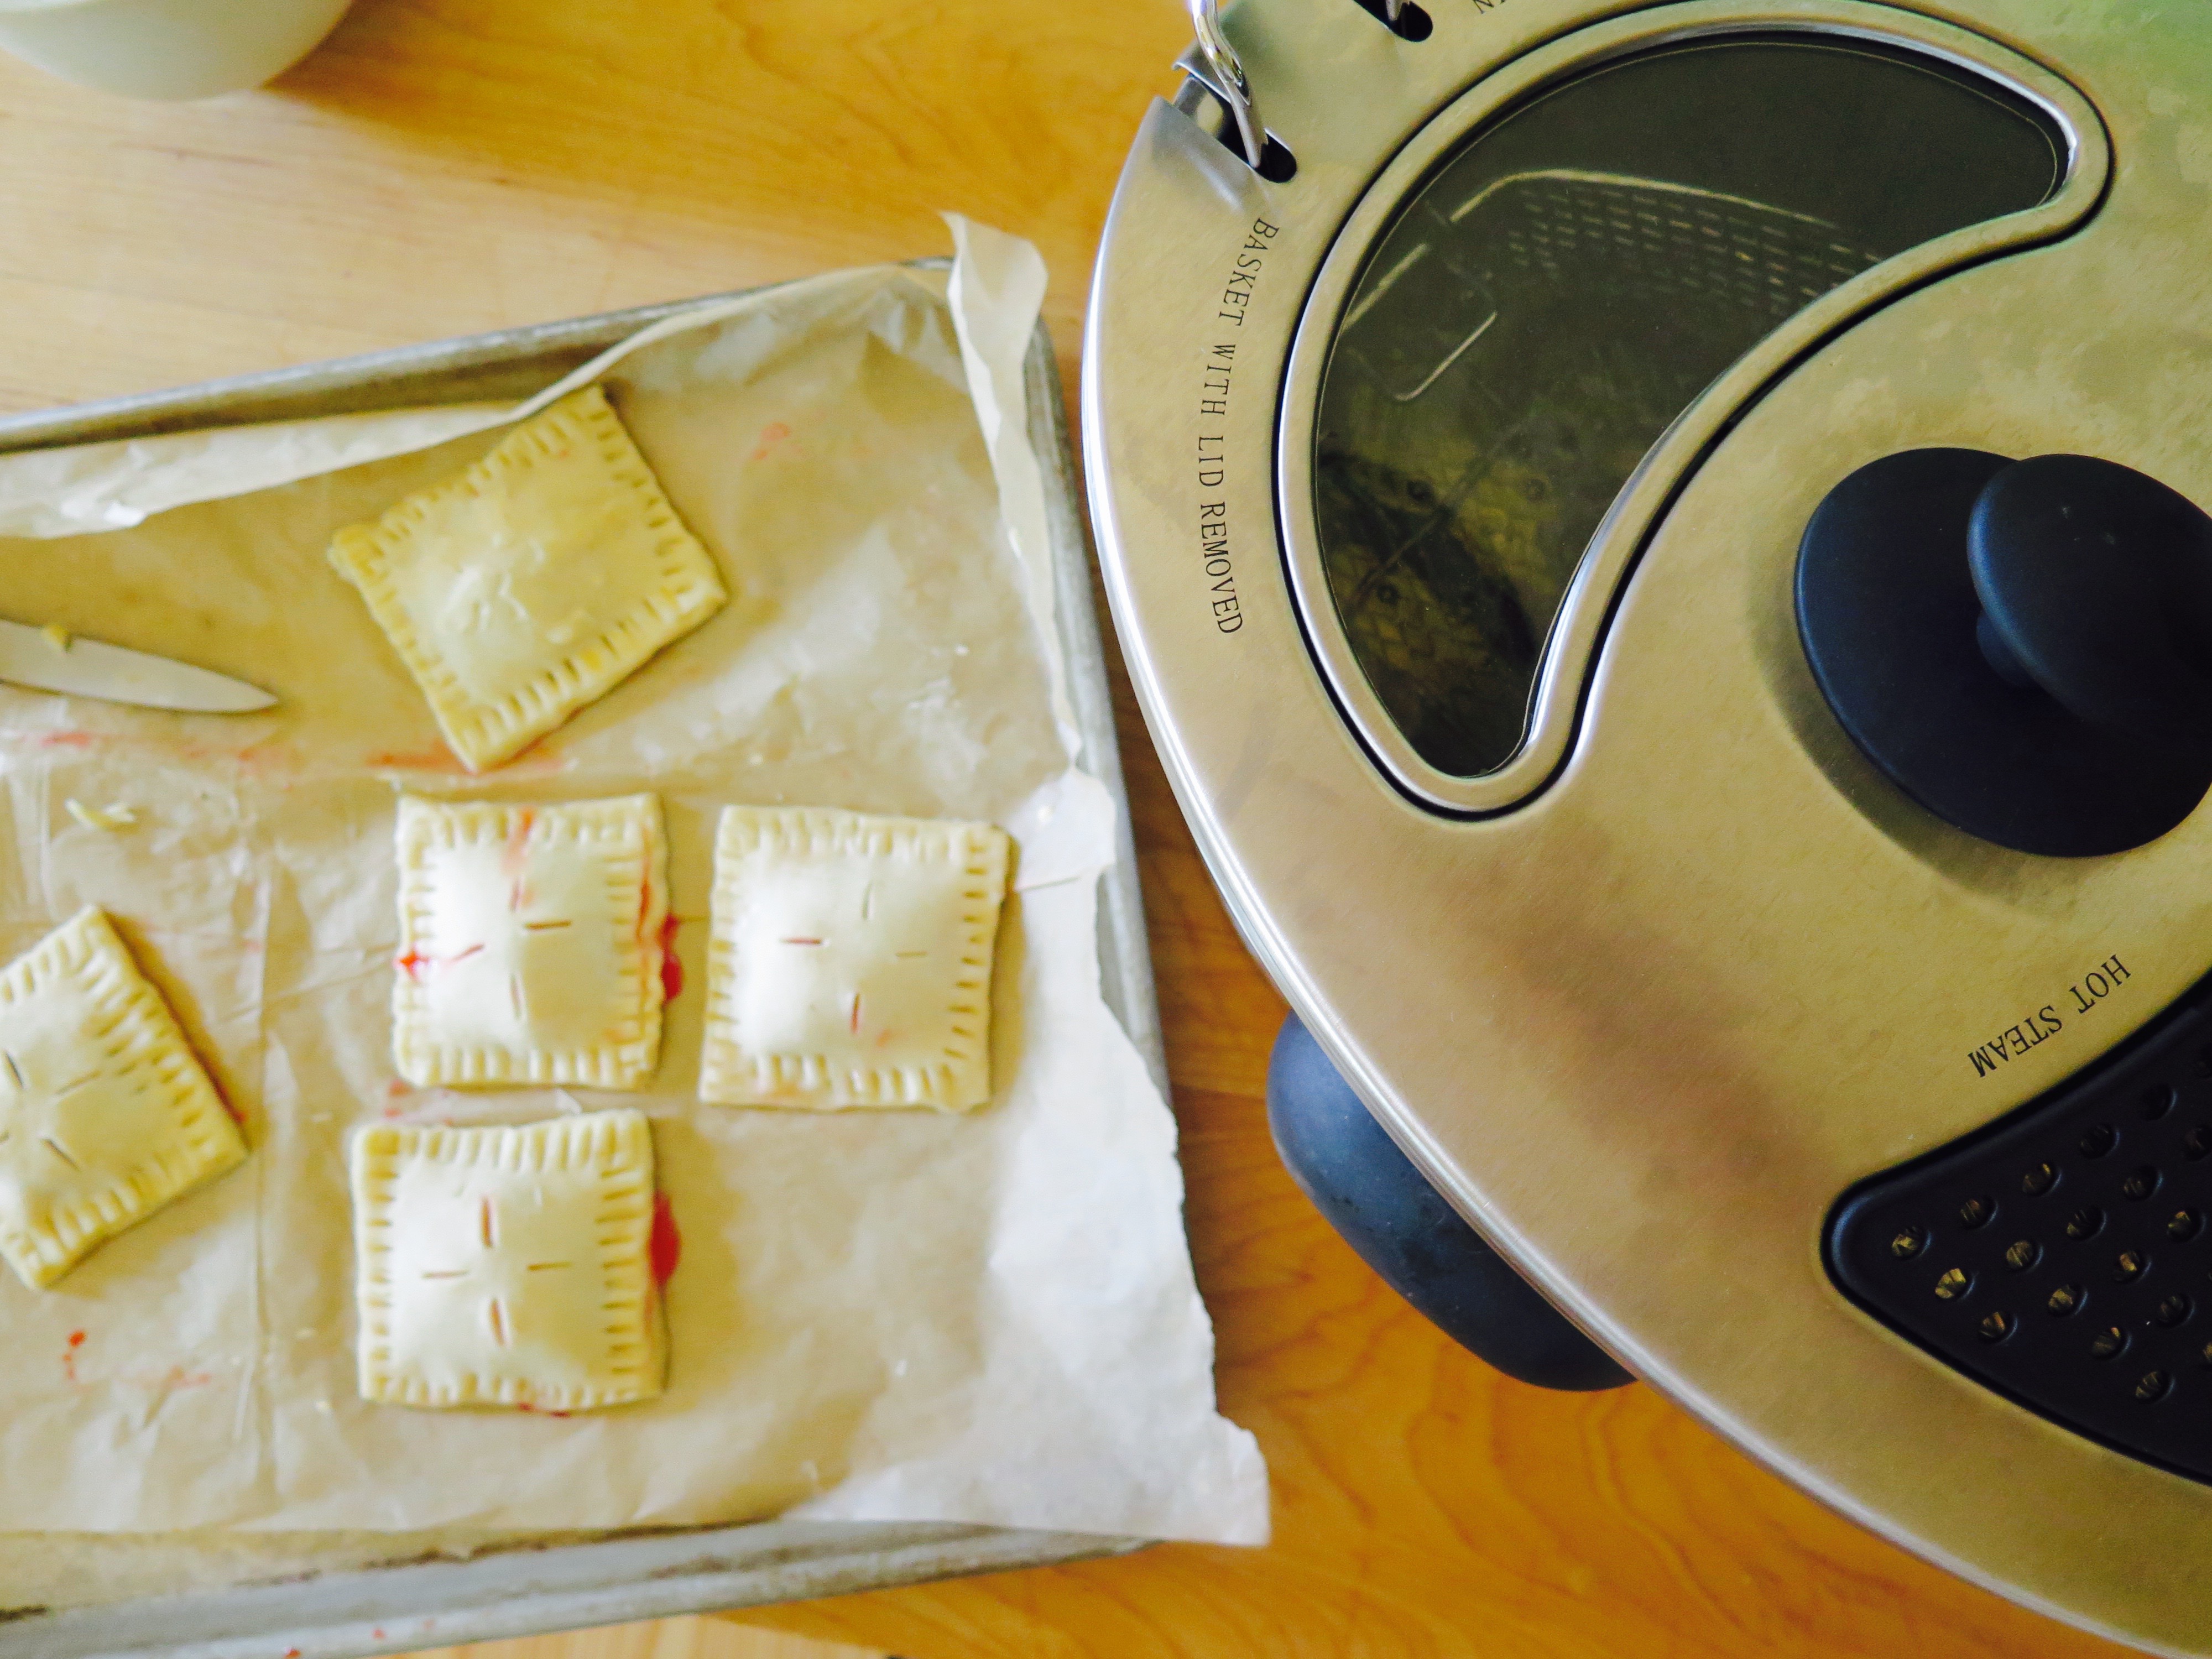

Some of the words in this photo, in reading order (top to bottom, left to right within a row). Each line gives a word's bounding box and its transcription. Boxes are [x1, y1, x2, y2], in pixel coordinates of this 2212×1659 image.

[1218, 218, 1280, 326] BASKET
[1200, 343, 1237, 416] WITH
[1198, 435, 1224, 488] LID
[1200, 500, 1244, 634] REMOVED
[2069, 954, 2131, 1014] HOT
[1968, 1005, 2063, 1078] STEAM
